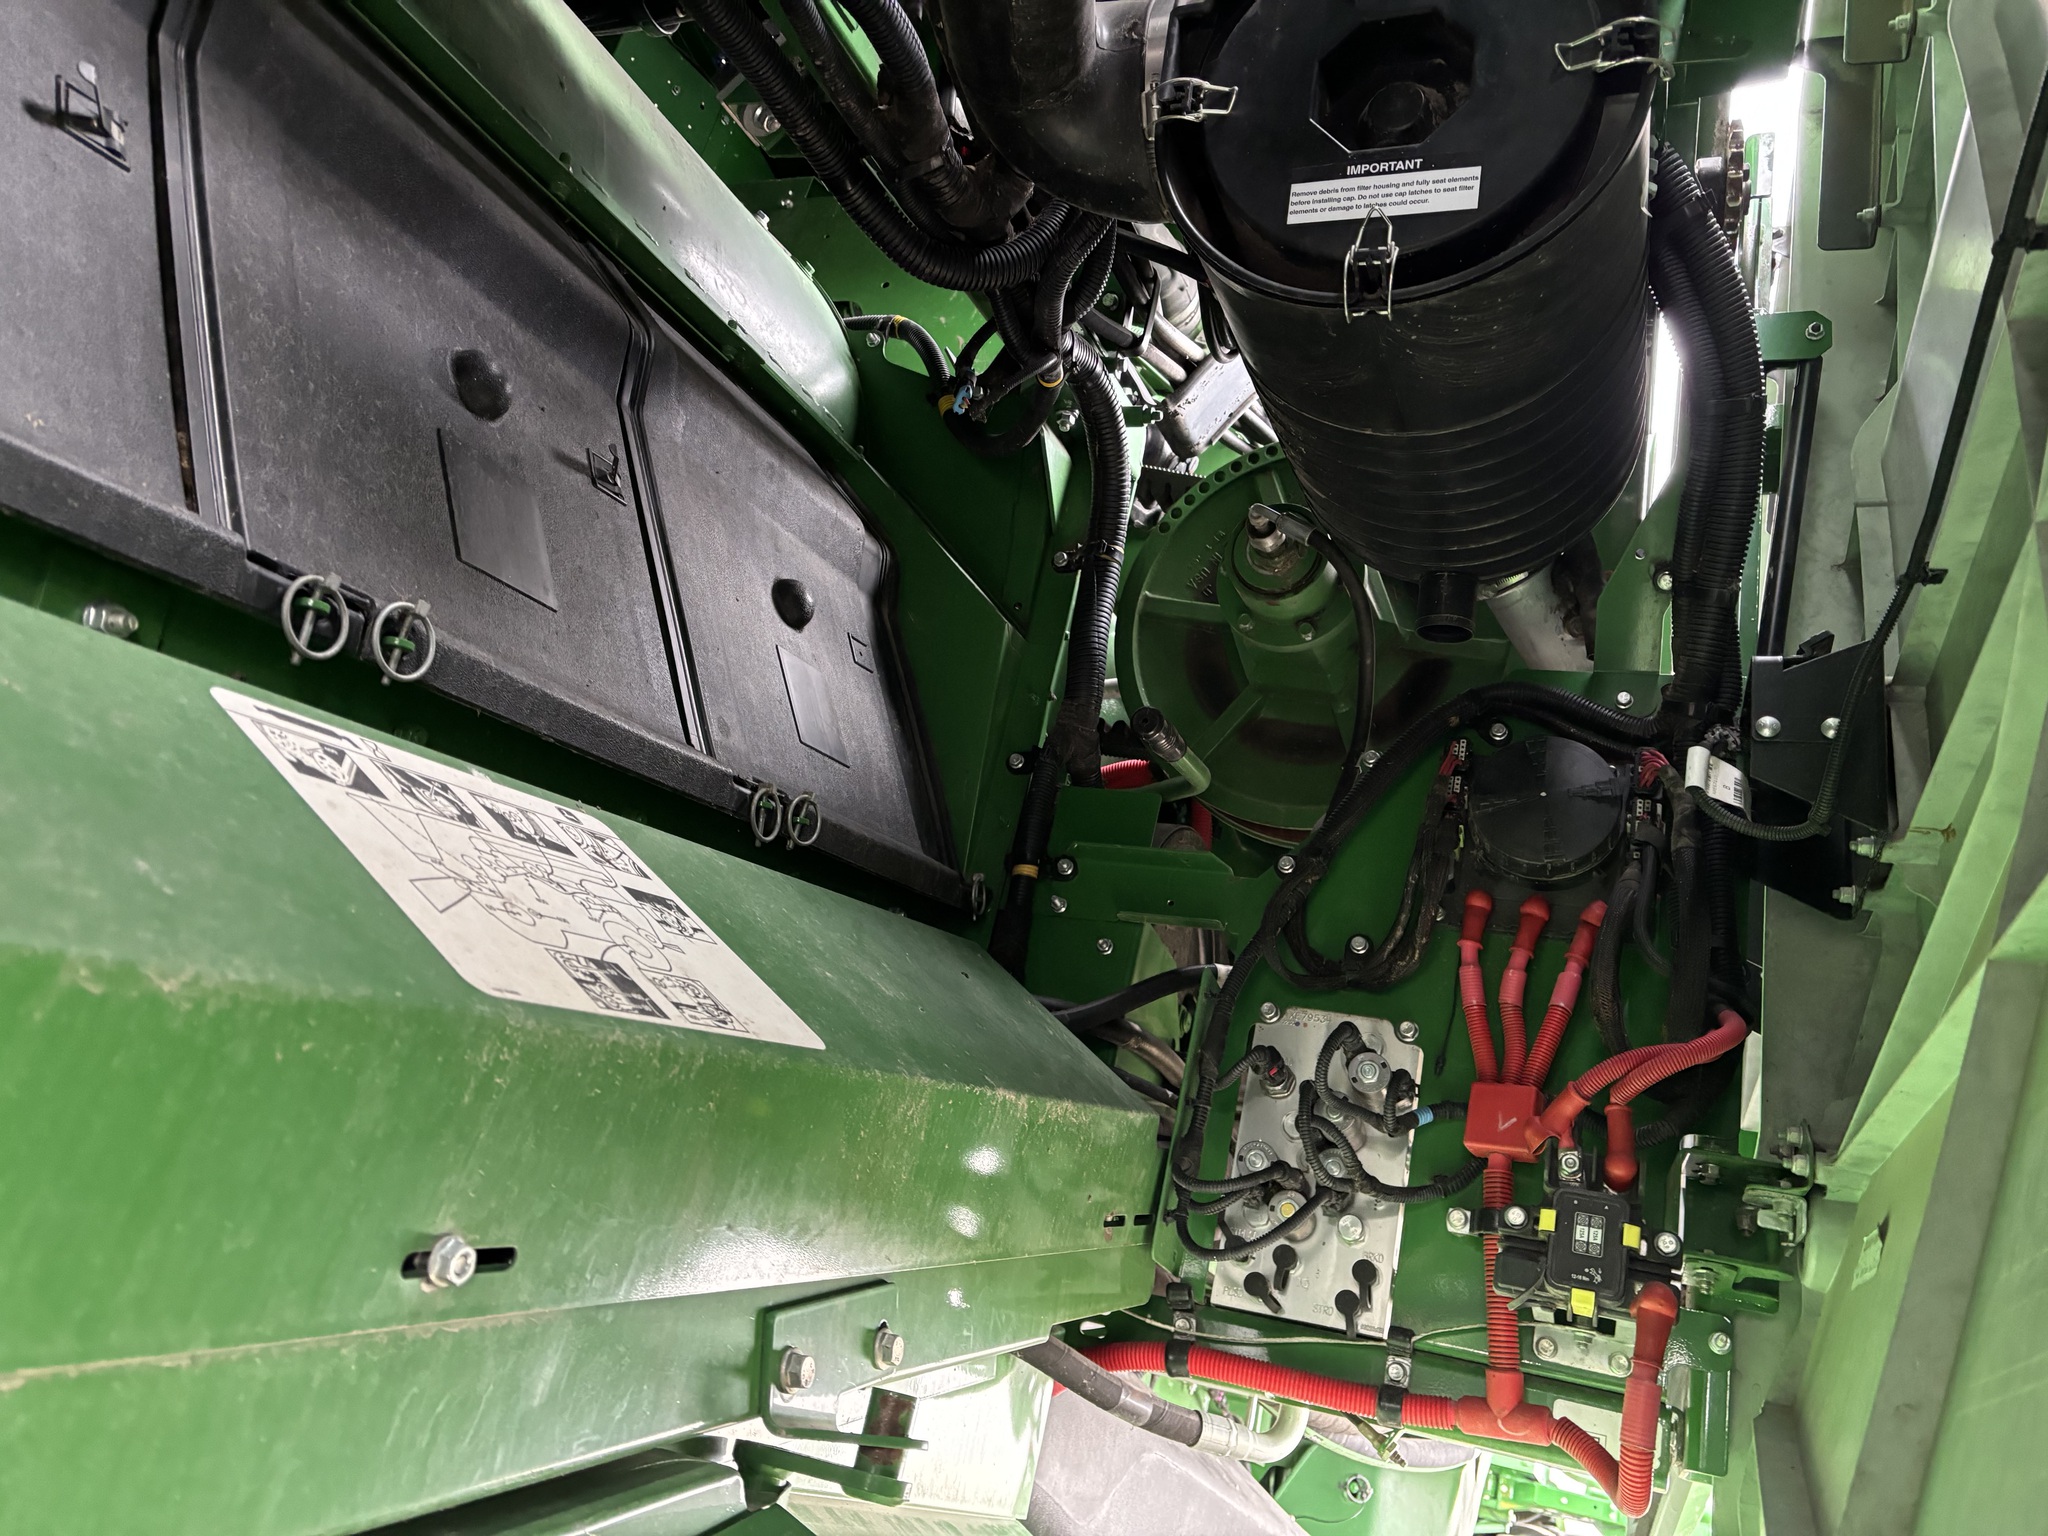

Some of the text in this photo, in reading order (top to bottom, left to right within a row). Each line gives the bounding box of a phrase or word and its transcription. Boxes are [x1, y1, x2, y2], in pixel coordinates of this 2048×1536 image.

[1347, 159, 1423, 175] IMPORTANT
[1291, 189, 1318, 198] Remove
[1318, 187, 1339, 195] debris
[1357, 184, 1372, 192] filter
[1373, 181, 1400, 190] housing
[1401, 180, 1415, 188] and
[1415, 179, 1430, 188] fully
[1431, 177, 1446, 185] seat
[1447, 175, 1479, 183] elements
[1289, 207, 1319, 216] elements
[1328, 204, 1354, 213] damage
[1363, 201, 1387, 209] latches
[1408, 197, 1430, 206] occur.
[1290, 199, 1311, 207] before
[1312, 197, 1341, 205] installing
[1381, 191, 1394, 199] use
[1394, 190, 1407, 198] cap
[1408, 188, 1433, 196] latches
[1187, 567, 1211, 588] USA
